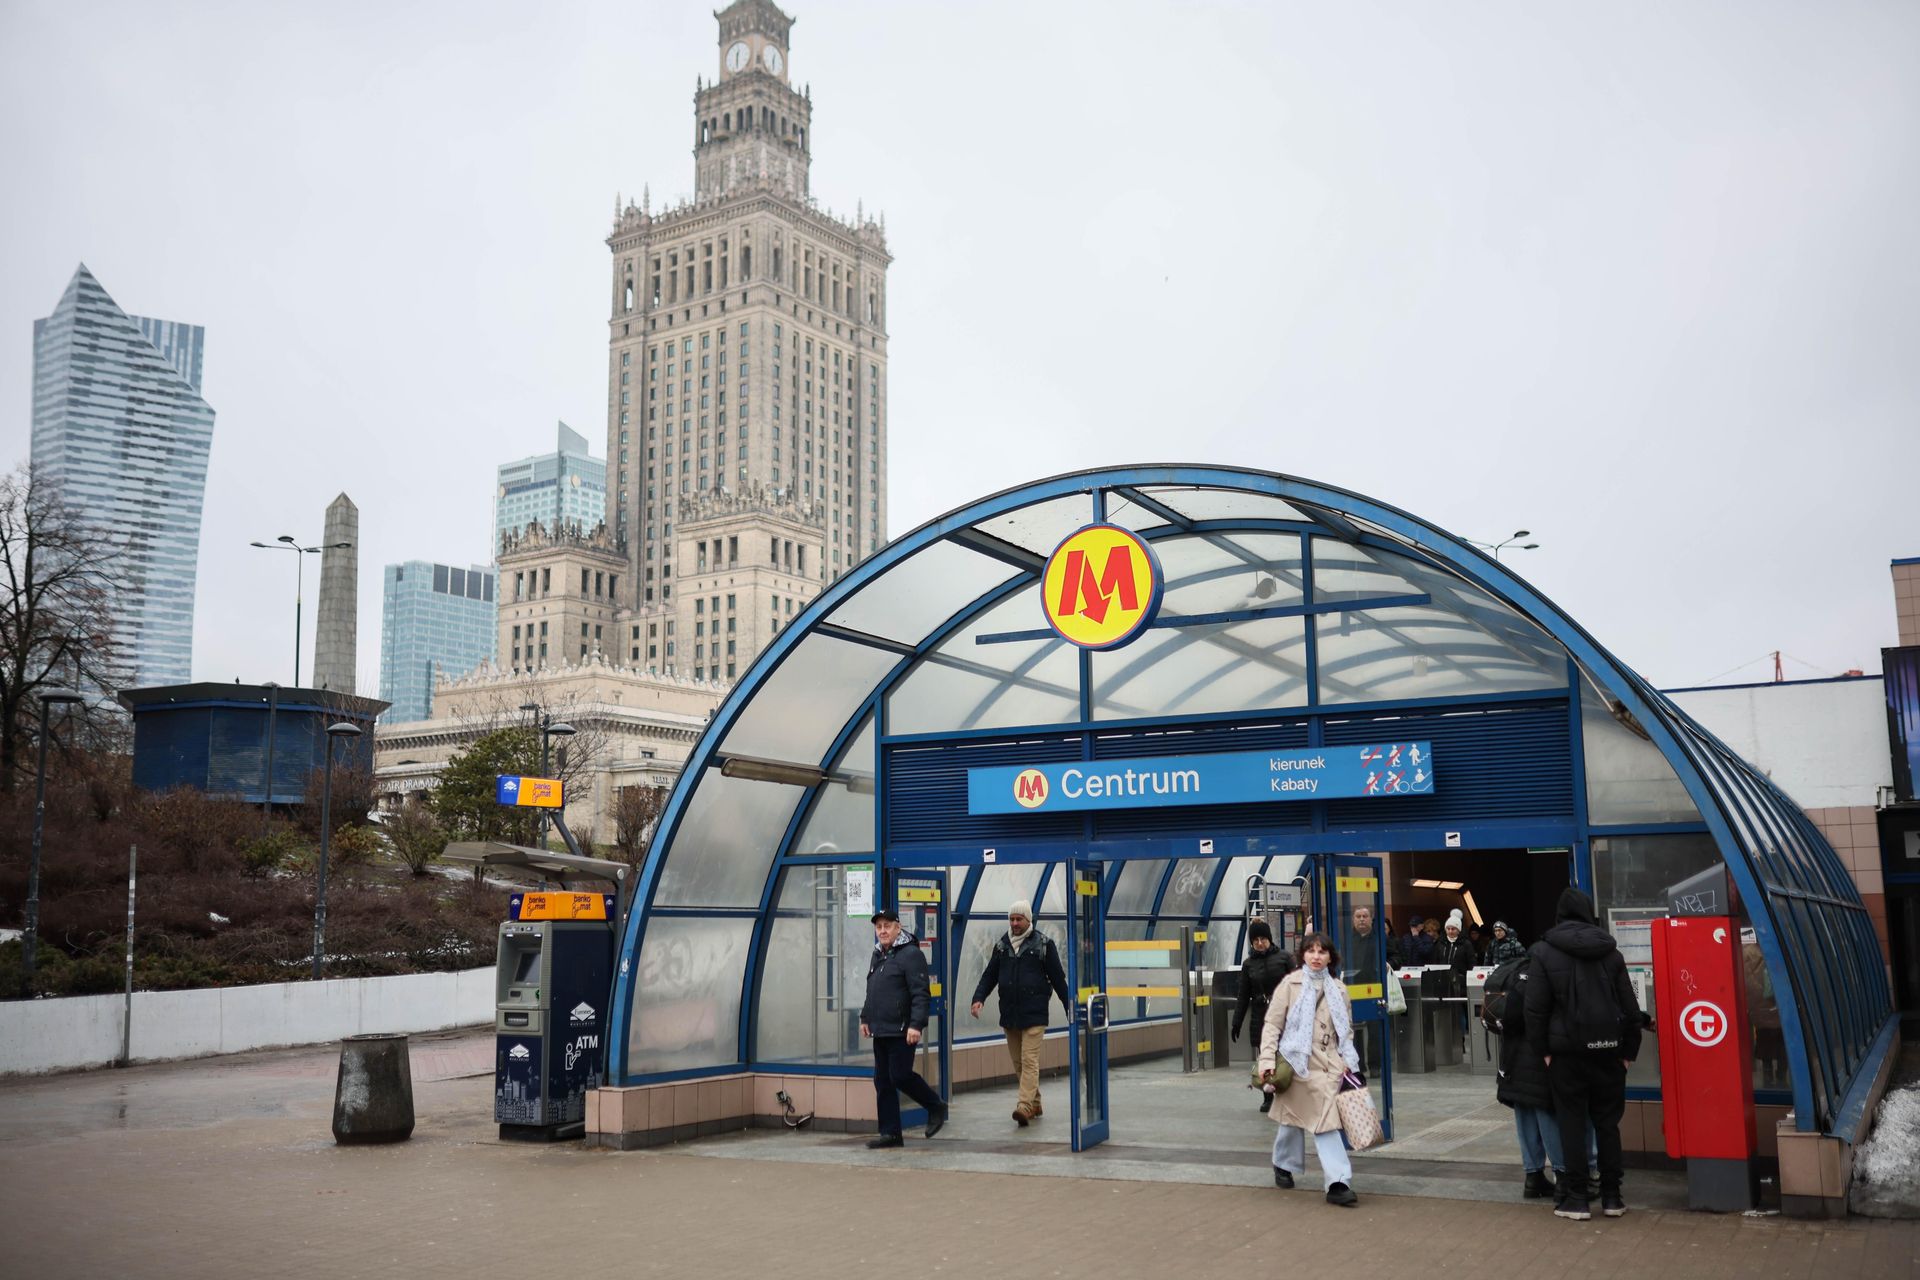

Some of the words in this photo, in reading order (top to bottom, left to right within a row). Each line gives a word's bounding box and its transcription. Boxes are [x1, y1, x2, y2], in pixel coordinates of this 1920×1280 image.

[1058, 545, 1138, 625] M
[1270, 755, 1326, 772] kierunek
[1061, 768, 1200, 799] Centrum
[1271, 778, 1318, 793] Kabaty
[529, 896, 545, 904] banko
[574, 894, 591, 903] banko
[575, 1035, 598, 1050] ATM
[1587, 1040, 1618, 1049] adidas
